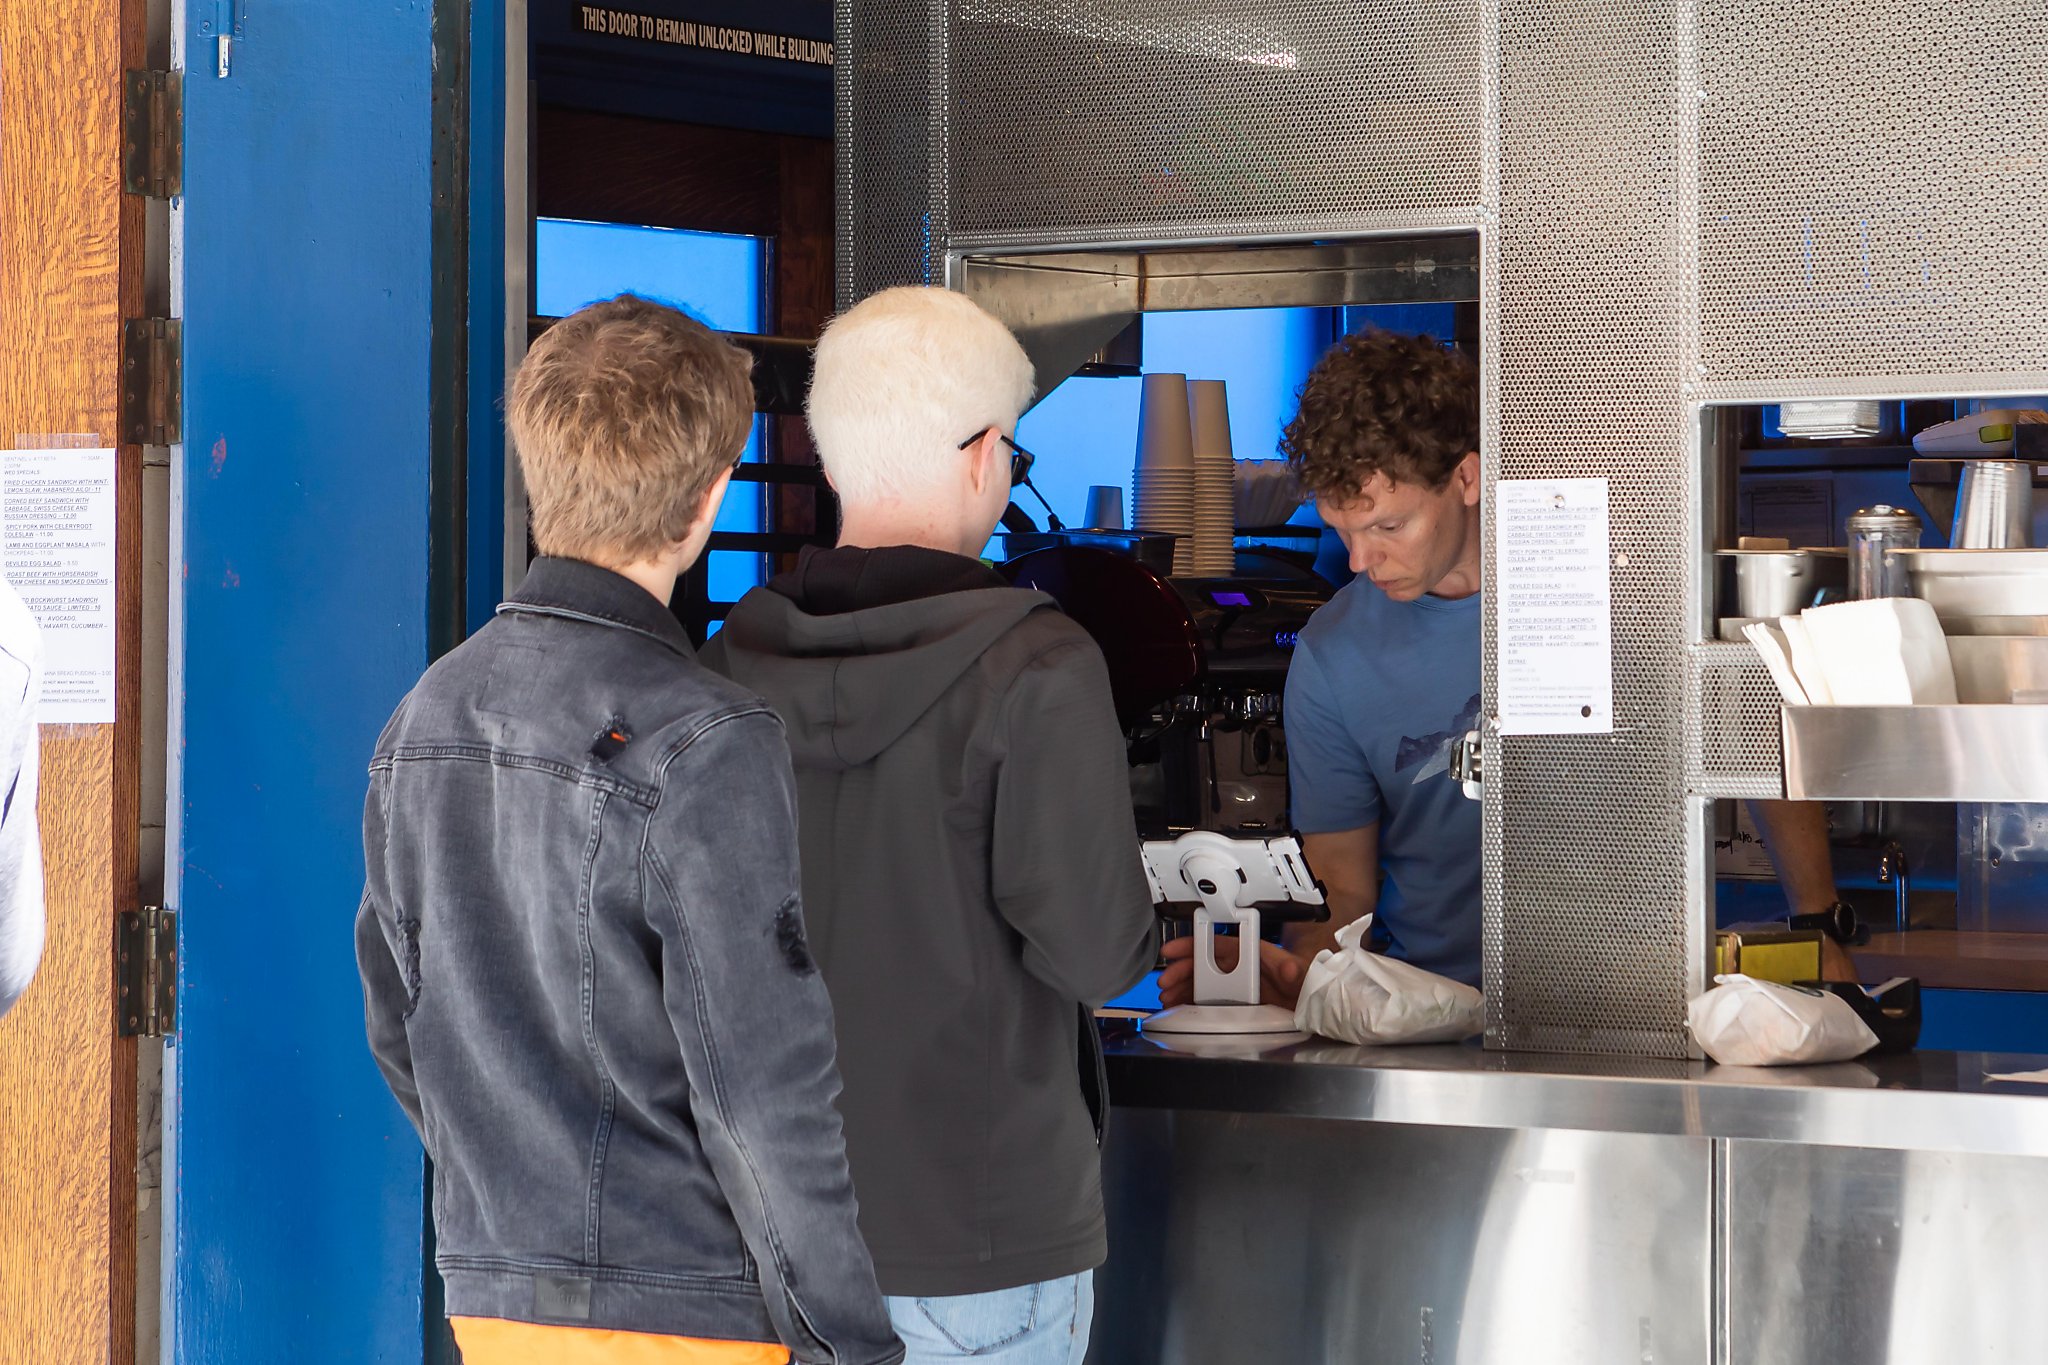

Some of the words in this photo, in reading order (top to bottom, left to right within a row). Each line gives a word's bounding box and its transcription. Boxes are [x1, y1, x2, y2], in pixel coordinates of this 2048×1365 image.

[582, 7, 606, 32] THIS
[609, 11, 638, 37] DOOR
[640, 16, 653, 39] TO
[657, 19, 696, 46] REMAIN
[699, 24, 752, 54] UNLOCKED
[754, 33, 786, 58] WHILE
[788, 38, 833, 65] BUILDING
